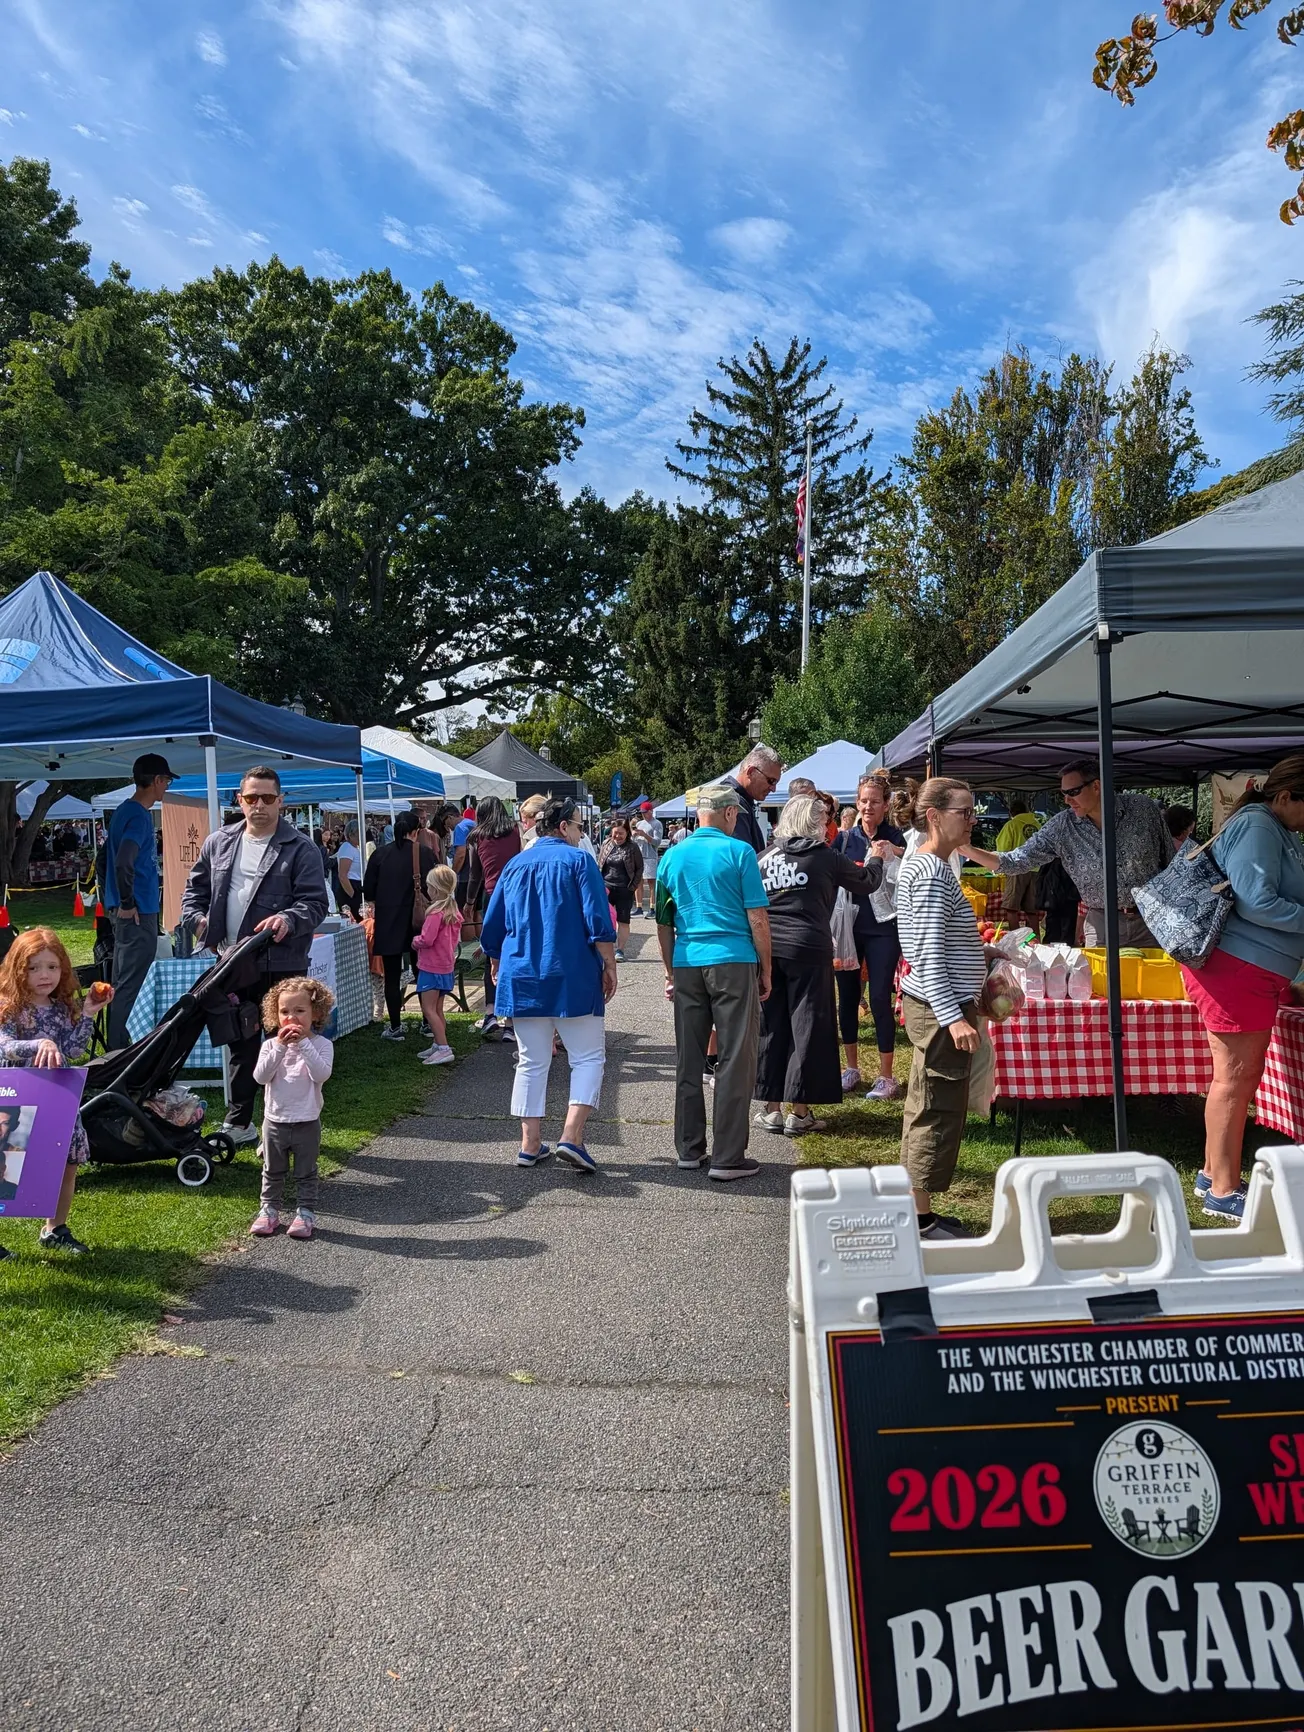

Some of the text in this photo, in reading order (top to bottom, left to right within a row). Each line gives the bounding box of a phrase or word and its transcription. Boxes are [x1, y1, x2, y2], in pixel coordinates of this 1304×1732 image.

[763, 853, 786, 869] THE
[766, 861, 798, 878] CLAY
[762, 871, 809, 892] TUDIO
[826, 1212, 895, 1233] Signicade
[937, 1332, 1304, 1369] THE WINCHESTER CHAMBER OF COMMER
[947, 1372, 985, 1394] AND
[990, 1370, 1026, 1392] THE
[1030, 1364, 1144, 1390] WINCHESTER
[1148, 1360, 1242, 1386] CULTURAL
[1105, 1394, 1179, 1415] PRESENT
[1142, 1432, 1158, 1456] g
[1107, 1462, 1201, 1482] GRIFFIN
[887, 1463, 1067, 1532] 2026
[1121, 1482, 1192, 1496] TERRACE
[1137, 1494, 1180, 1505] SERIES
[886, 1575, 1304, 1732] BEER GAR
